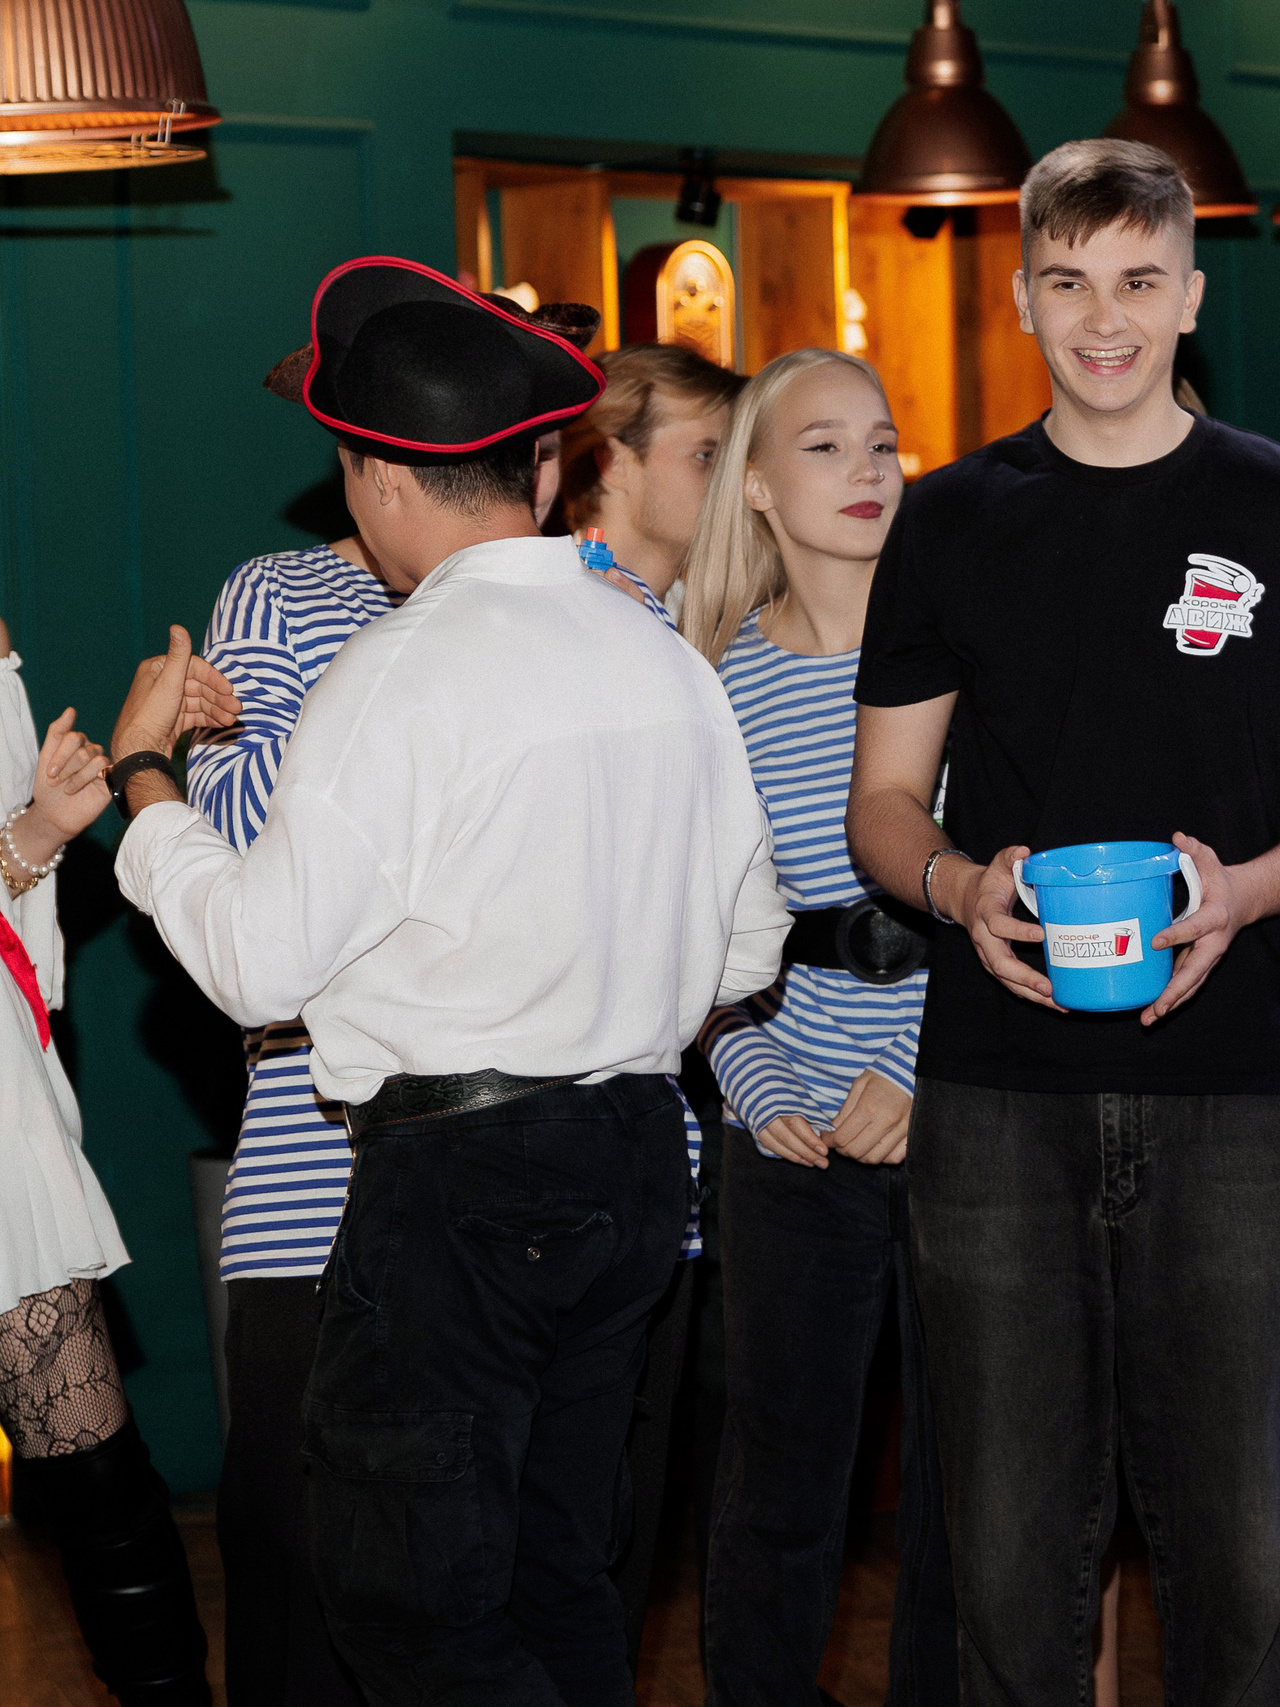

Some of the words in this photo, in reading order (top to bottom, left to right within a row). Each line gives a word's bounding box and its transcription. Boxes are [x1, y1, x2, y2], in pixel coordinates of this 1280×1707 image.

[1182, 598, 1238, 611] короче
[1167, 607, 1249, 633] ДВИЖ
[1057, 933, 1100, 942] короче
[1052, 941, 1115, 958] ДВИЖ
